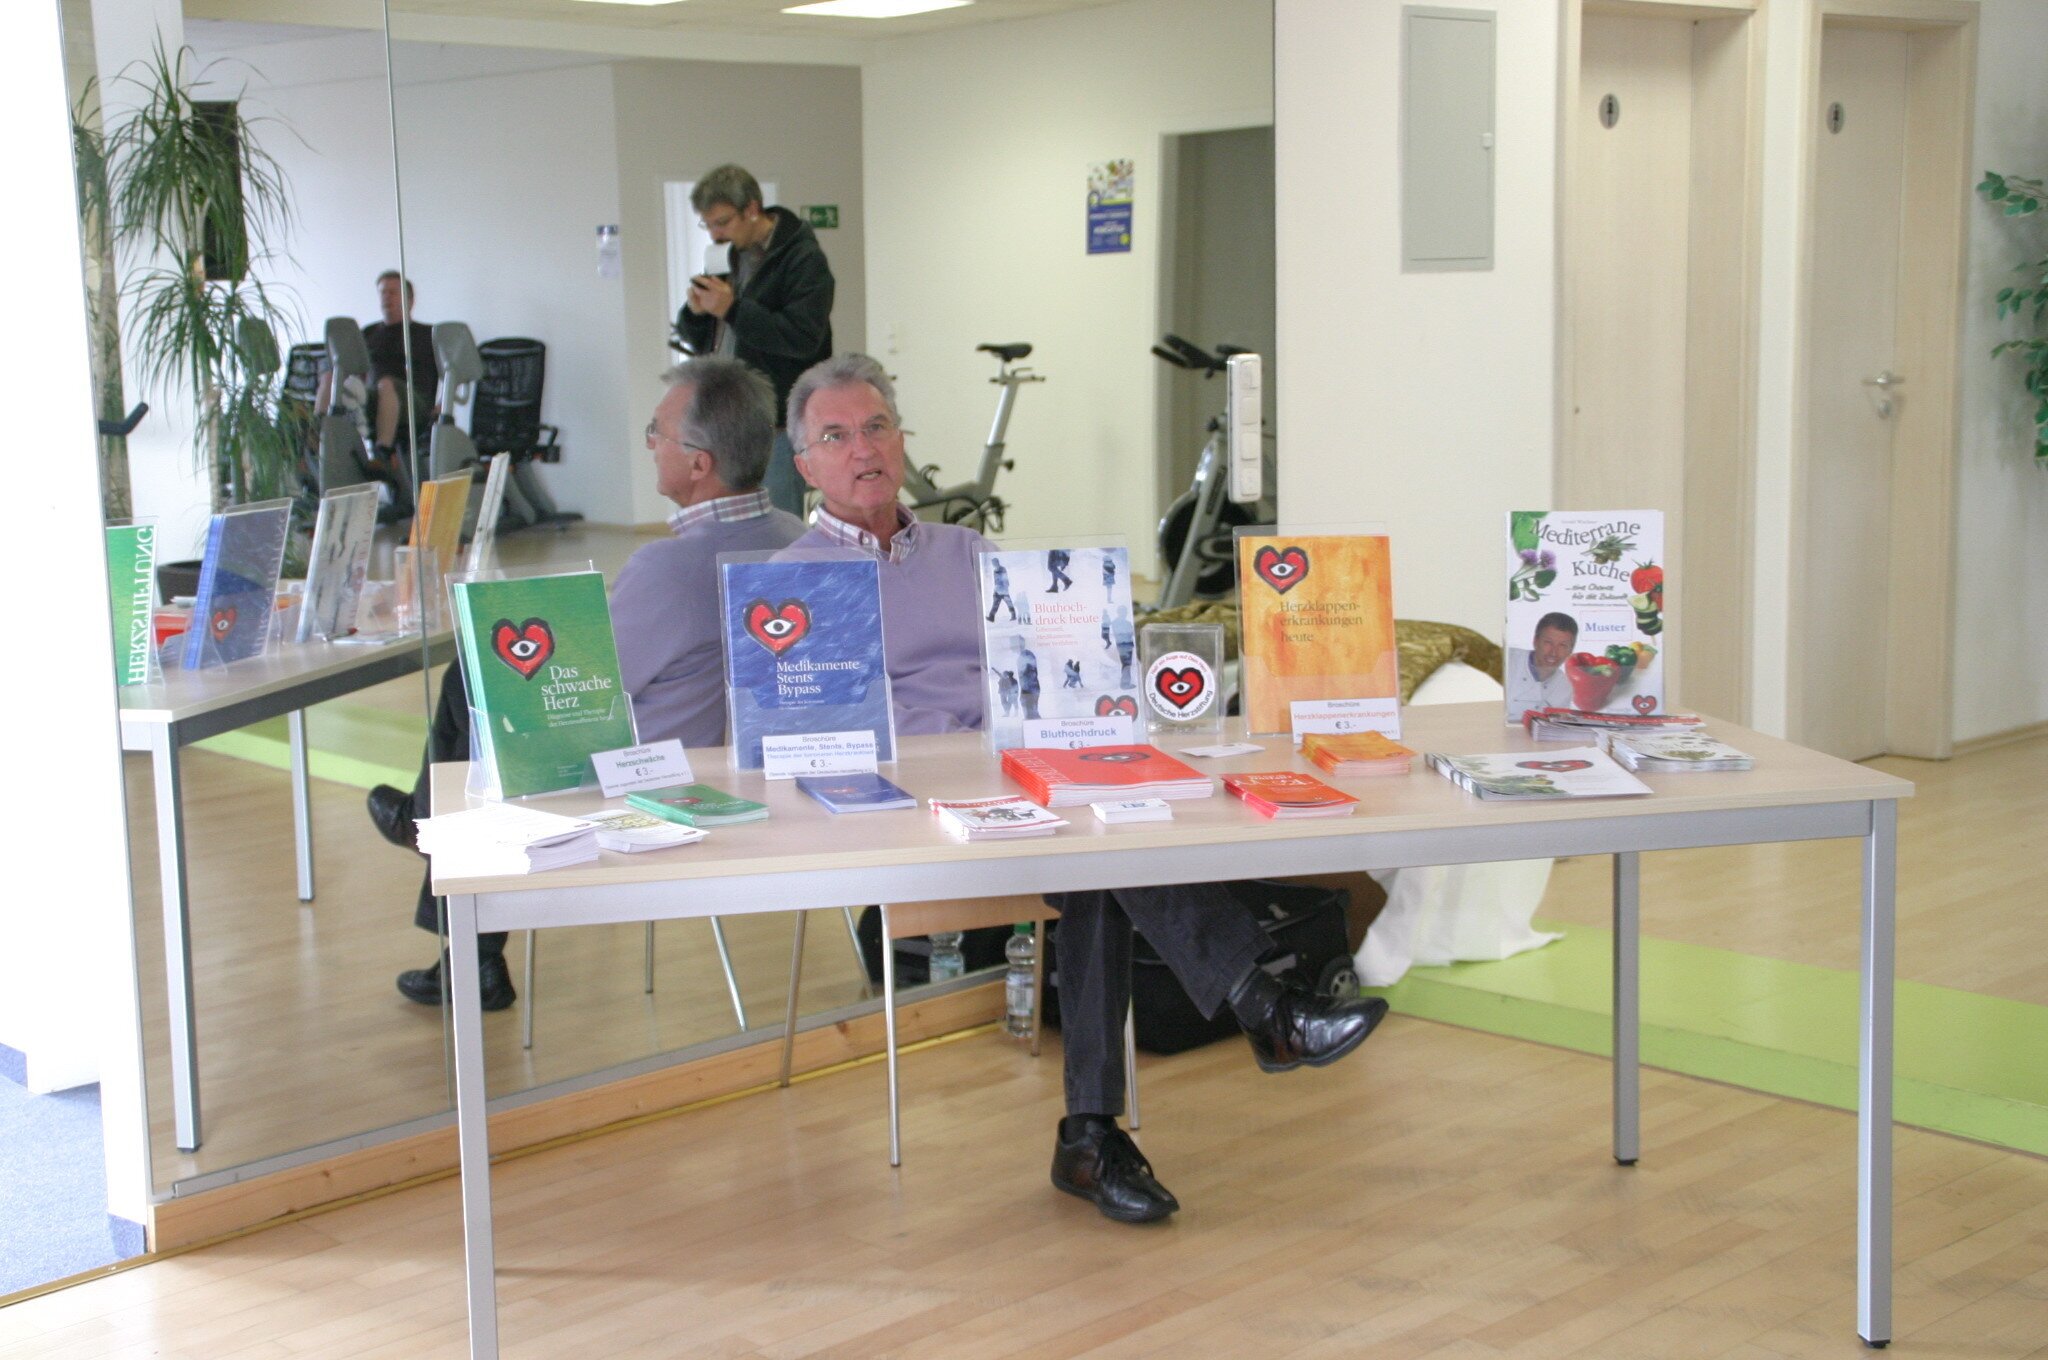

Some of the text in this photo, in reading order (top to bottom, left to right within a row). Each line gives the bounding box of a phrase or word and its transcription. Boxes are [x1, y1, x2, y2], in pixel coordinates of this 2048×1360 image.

[1529, 519, 1641, 546] Mediterrane
[1572, 560, 1630, 582] Küche
[1034, 602, 1087, 613] Bluthoch-
[1280, 600, 1360, 615] Herzklappen-
[1035, 614, 1099, 625] druck heute
[1280, 614, 1363, 628] erkrankungen
[1585, 622, 1626, 632] Muster
[1280, 631, 1313, 642] heute
[776, 660, 861, 672] Medikamente
[549, 665, 578, 680] Das
[776, 673, 813, 684] Stents
[541, 675, 612, 696] schwache
[778, 684, 821, 698] Bypass
[542, 696, 580, 711] Herz
[1149, 690, 1213, 718] Deutsche Herzstiftung
[1335, 721, 1342, 729] €
[1040, 728, 1117, 739] Bluthochdruck
[810, 759, 817, 767] €
[635, 768, 642, 776] €
